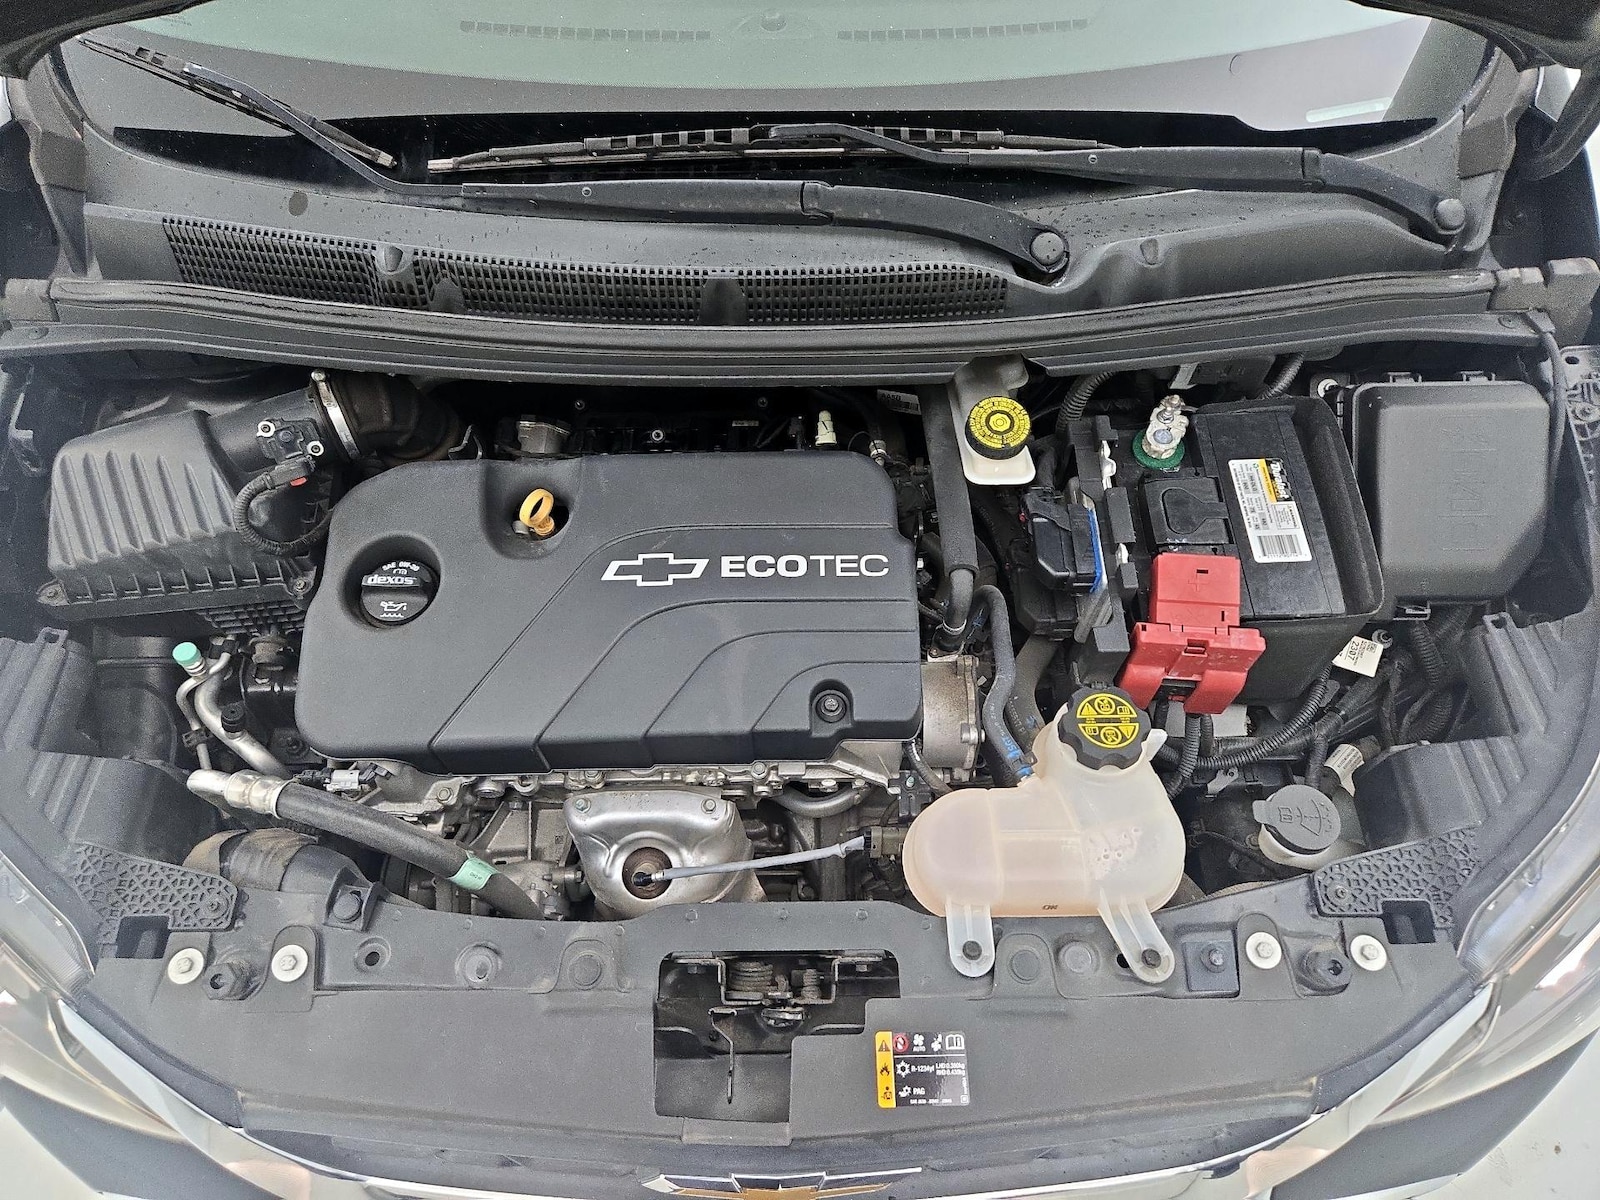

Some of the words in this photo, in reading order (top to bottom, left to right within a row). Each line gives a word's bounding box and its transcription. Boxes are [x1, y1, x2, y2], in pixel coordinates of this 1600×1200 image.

[1270, 461, 1290, 499] Duralast
[382, 561, 396, 570] SAE
[721, 554, 889, 578] ECOTEC
[367, 574, 414, 584] dexos
[1348, 640, 1360, 661] 2307
[912, 1087, 926, 1095] PAG
